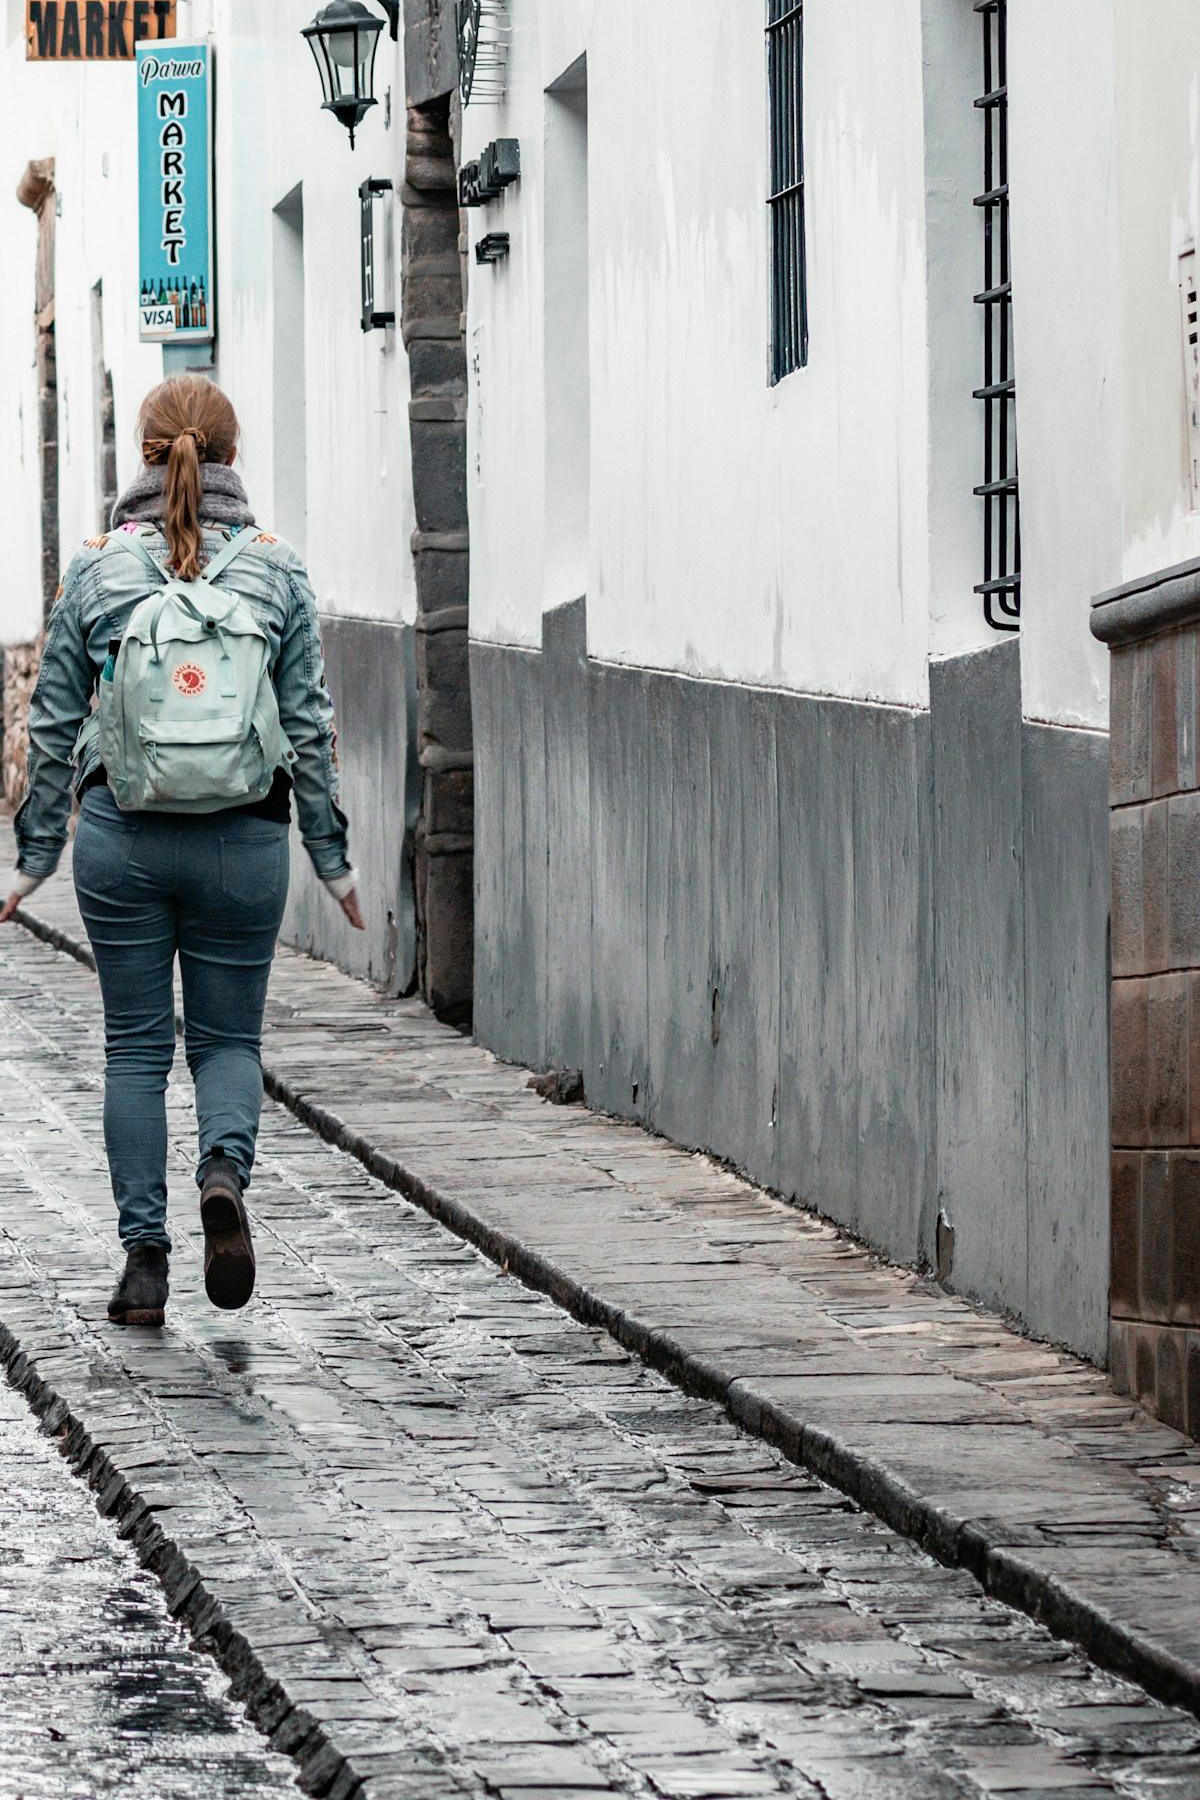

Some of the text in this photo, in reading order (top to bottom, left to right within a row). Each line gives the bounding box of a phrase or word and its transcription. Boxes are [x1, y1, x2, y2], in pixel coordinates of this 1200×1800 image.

[29, 0, 171, 57] MARKET
[141, 57, 202, 86] Parwa
[160, 92, 186, 263] MARKET
[142, 310, 174, 325] VISA
